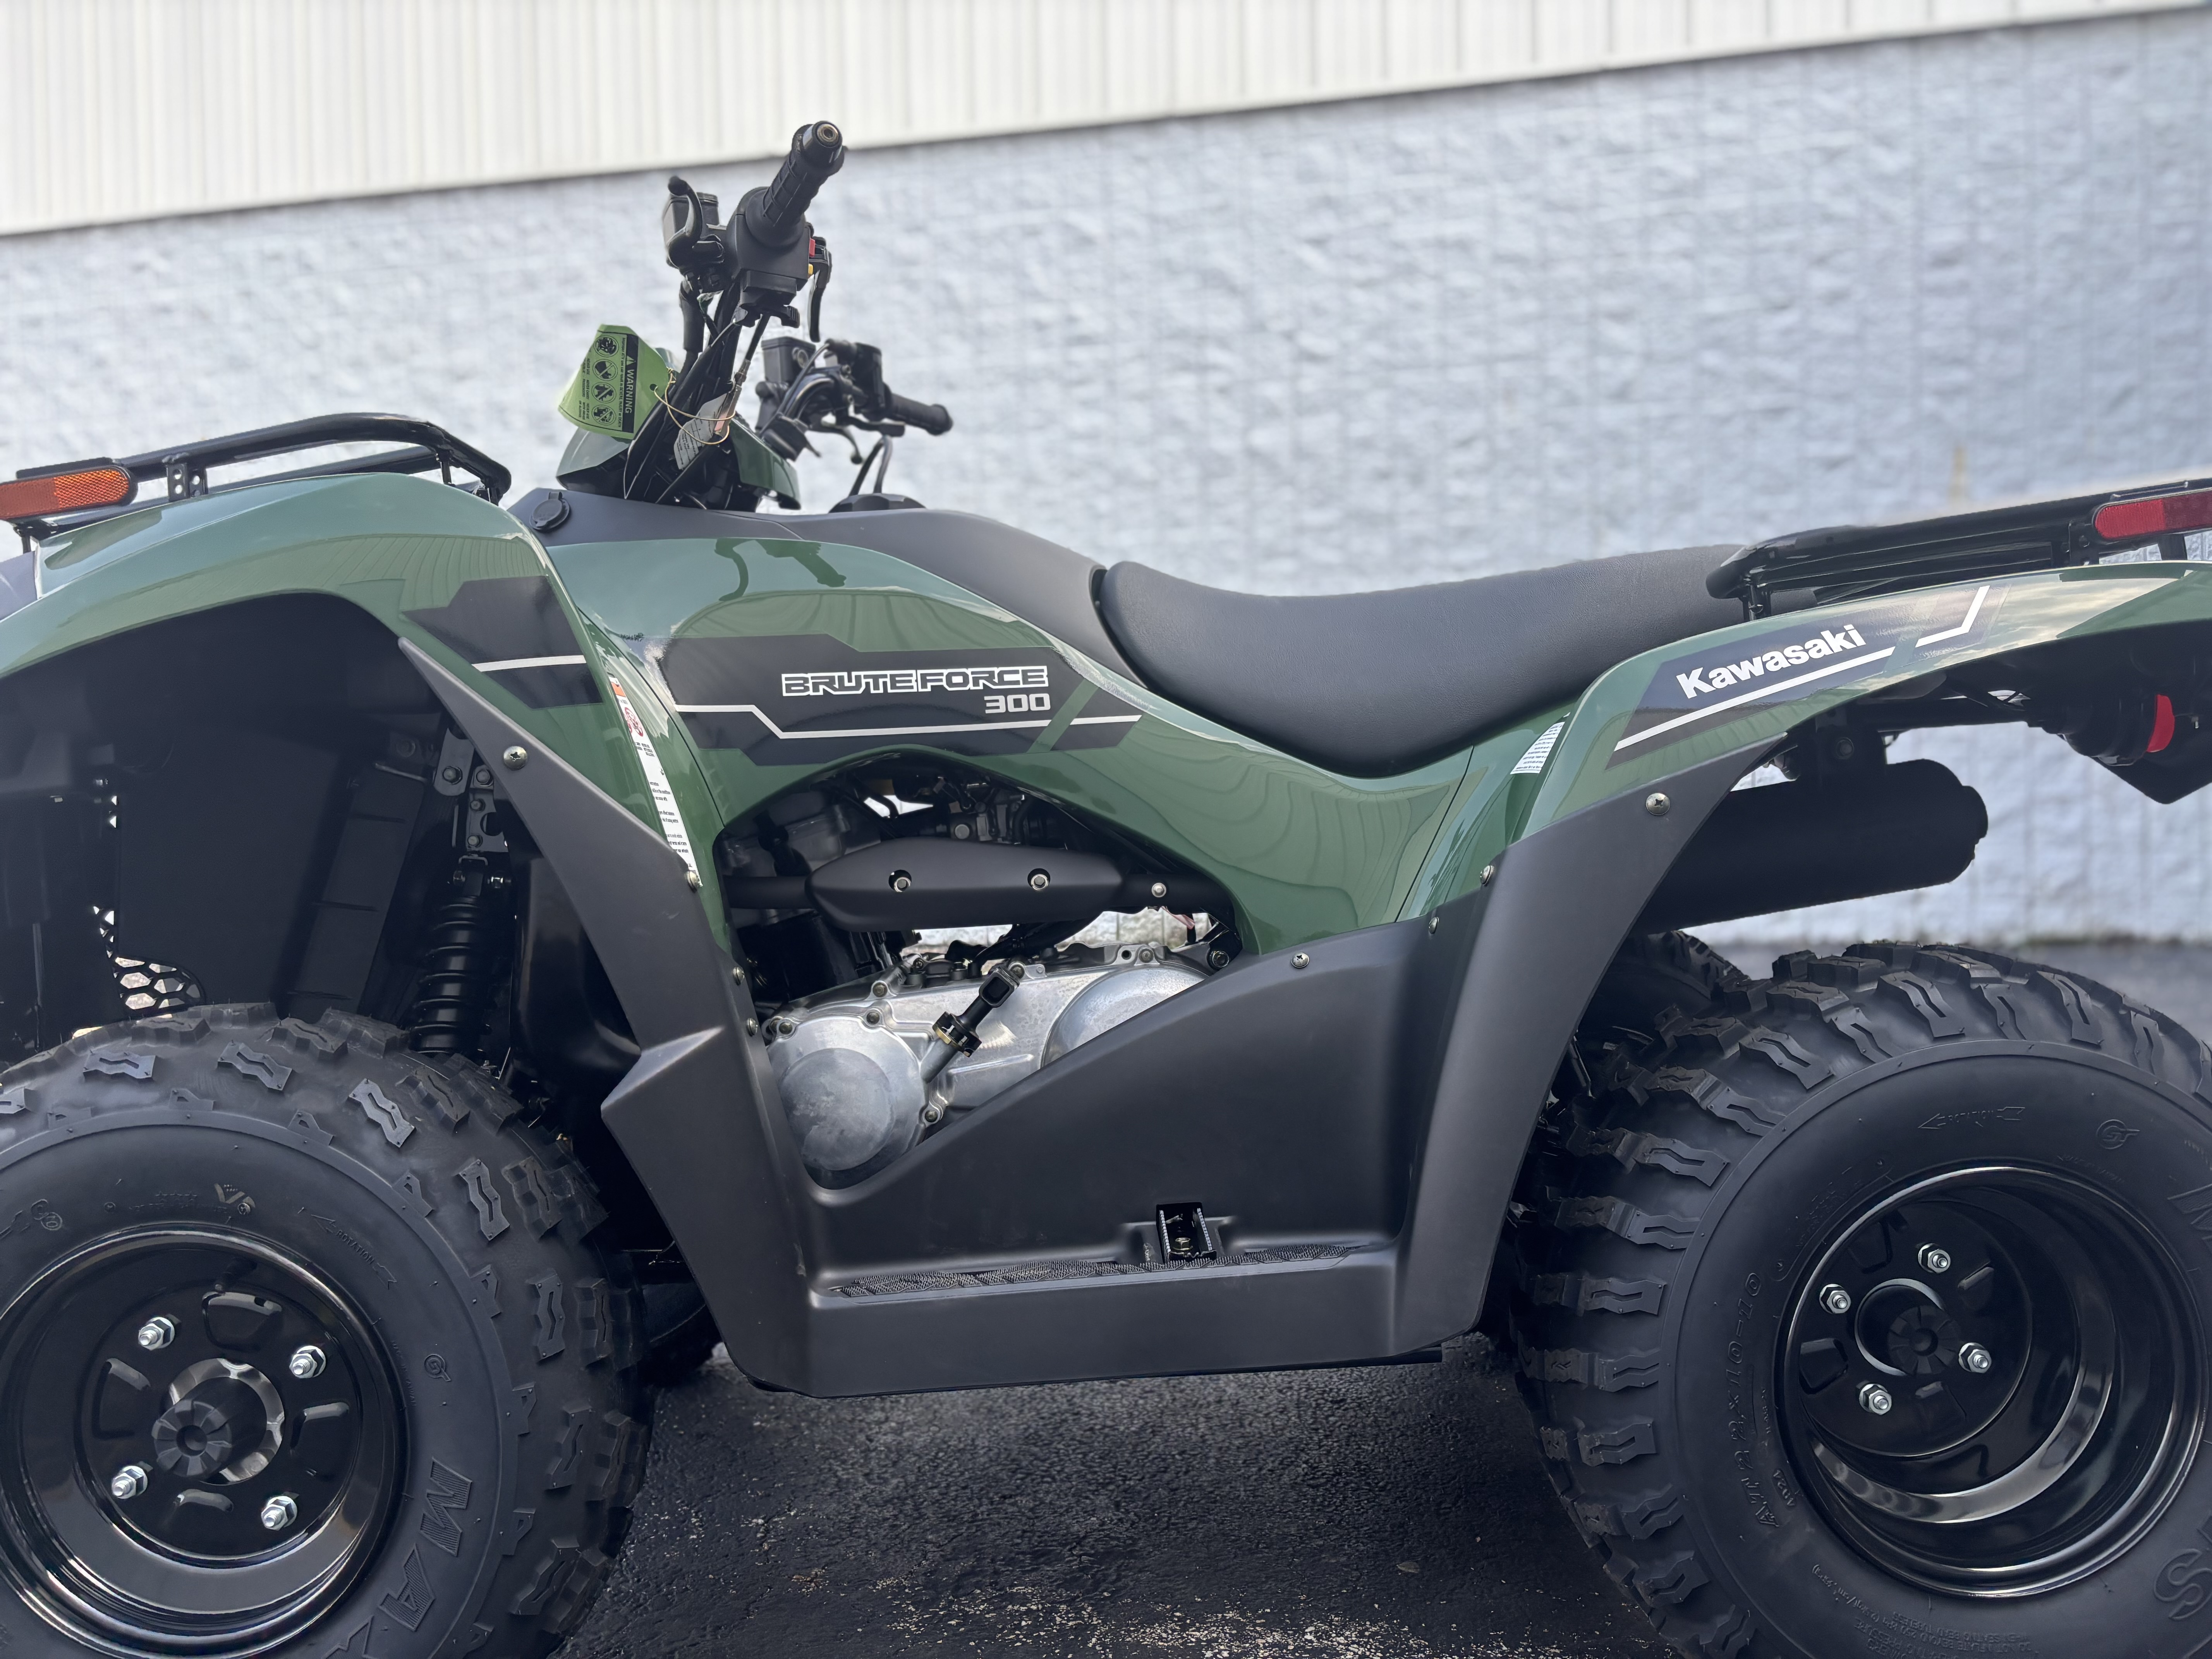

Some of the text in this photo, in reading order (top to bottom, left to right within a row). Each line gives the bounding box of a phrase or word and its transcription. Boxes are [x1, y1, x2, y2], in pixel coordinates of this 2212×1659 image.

[625, 369, 634, 413] WARNING
[1676, 624, 1866, 699] Kawasaki
[984, 693, 1050, 714] 300
[336, 1229, 375, 1264] ROTATION
